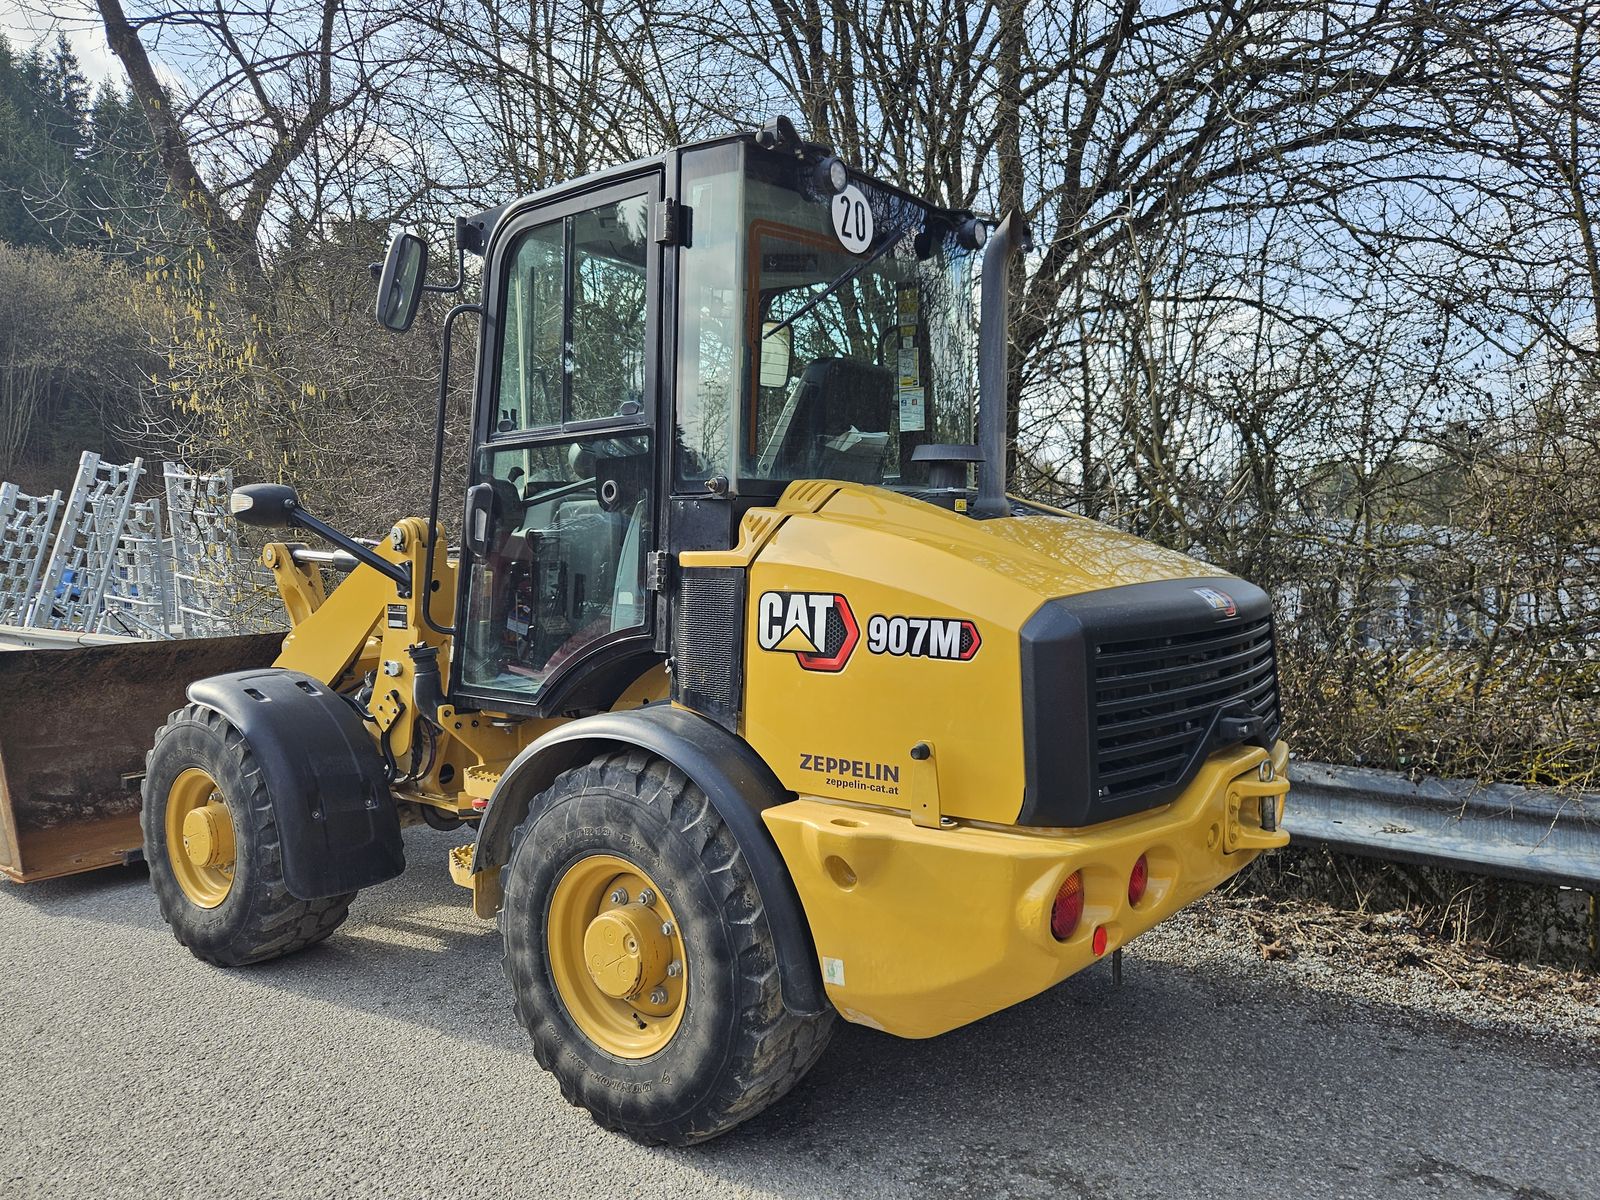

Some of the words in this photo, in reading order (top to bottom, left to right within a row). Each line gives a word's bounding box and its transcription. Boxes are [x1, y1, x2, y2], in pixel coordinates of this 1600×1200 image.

[840, 195, 866, 241] 20
[758, 592, 834, 653] CAT
[868, 616, 961, 659] 907M
[800, 753, 900, 783] ZEPPELIN
[825, 777, 899, 795] zeppelin-cat.at
